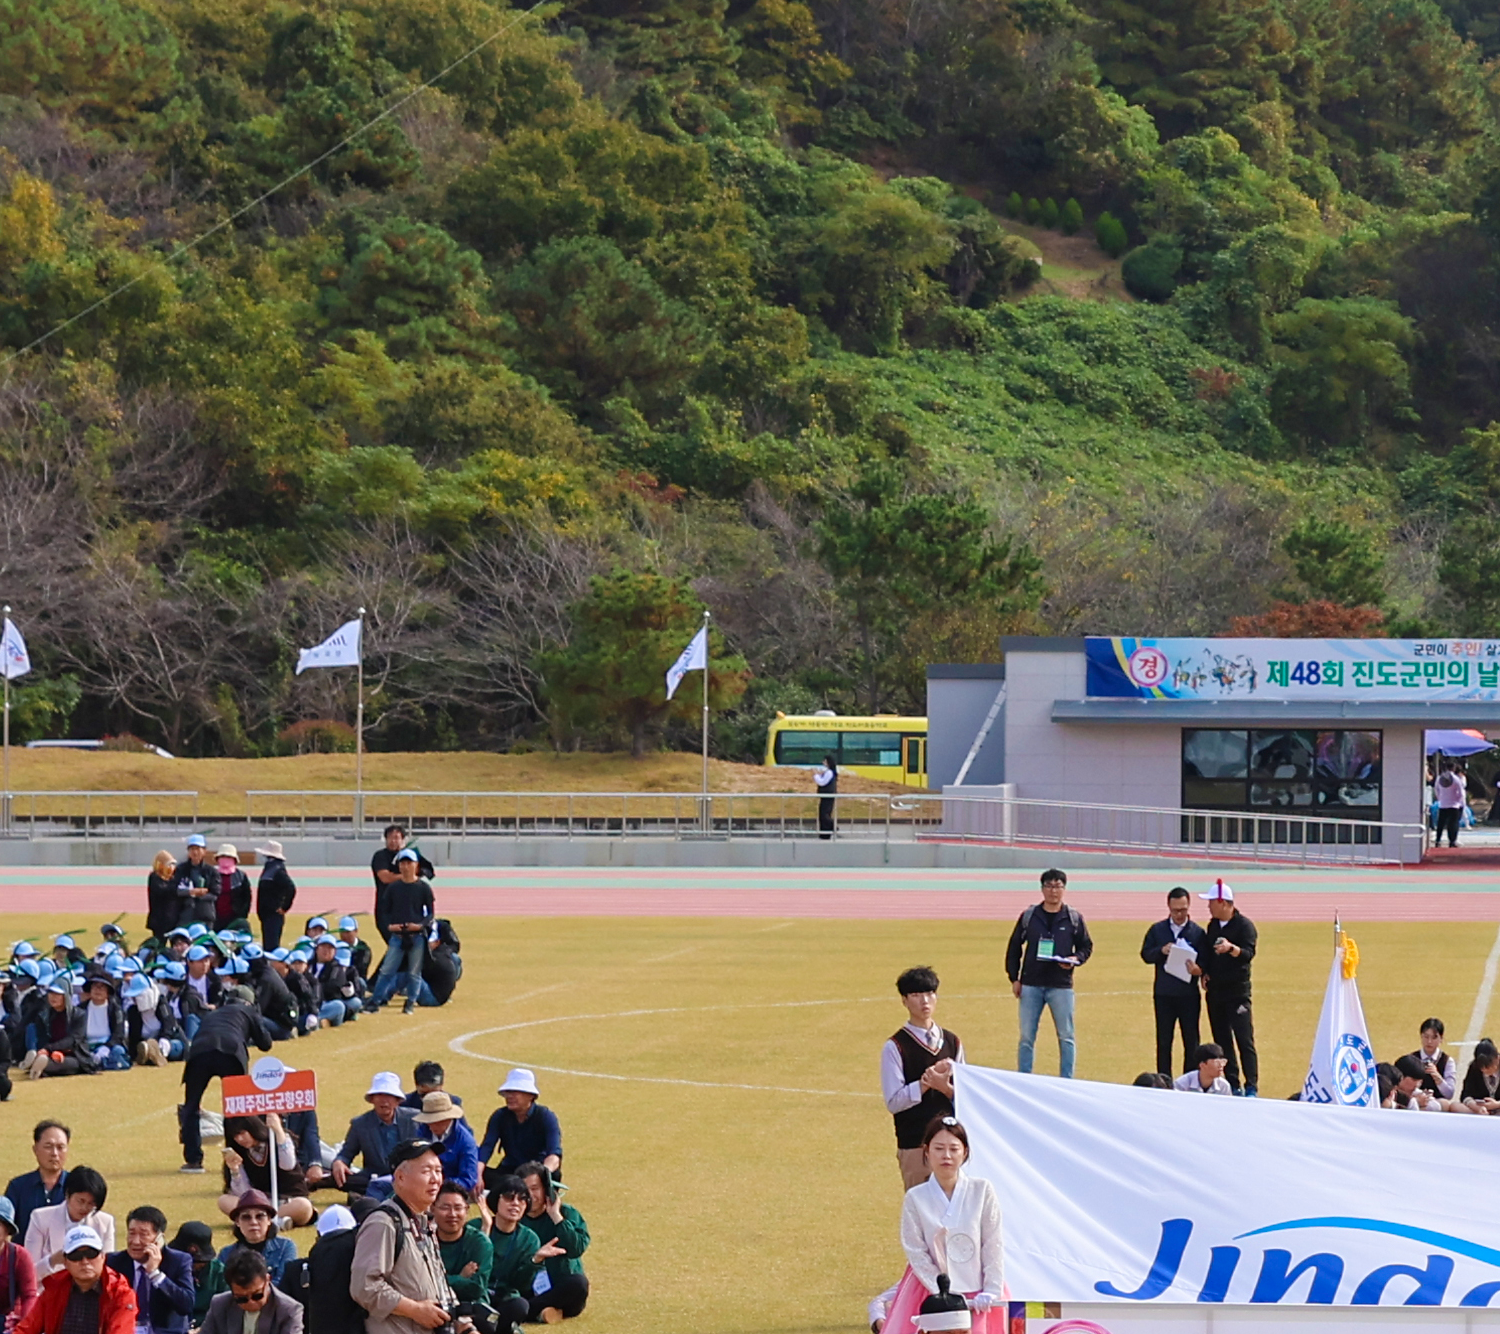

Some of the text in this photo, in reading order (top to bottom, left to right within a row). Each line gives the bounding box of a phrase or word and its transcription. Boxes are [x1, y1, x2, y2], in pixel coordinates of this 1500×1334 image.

[1414, 644, 1447, 656] 군민이
[1452, 642, 1482, 656] 주인!
[1138, 657, 1158, 679] 경
[1267, 660, 1344, 687] 제48회
[1352, 660, 1469, 688] 진도군민의
[1478, 661, 1500, 688] 날
